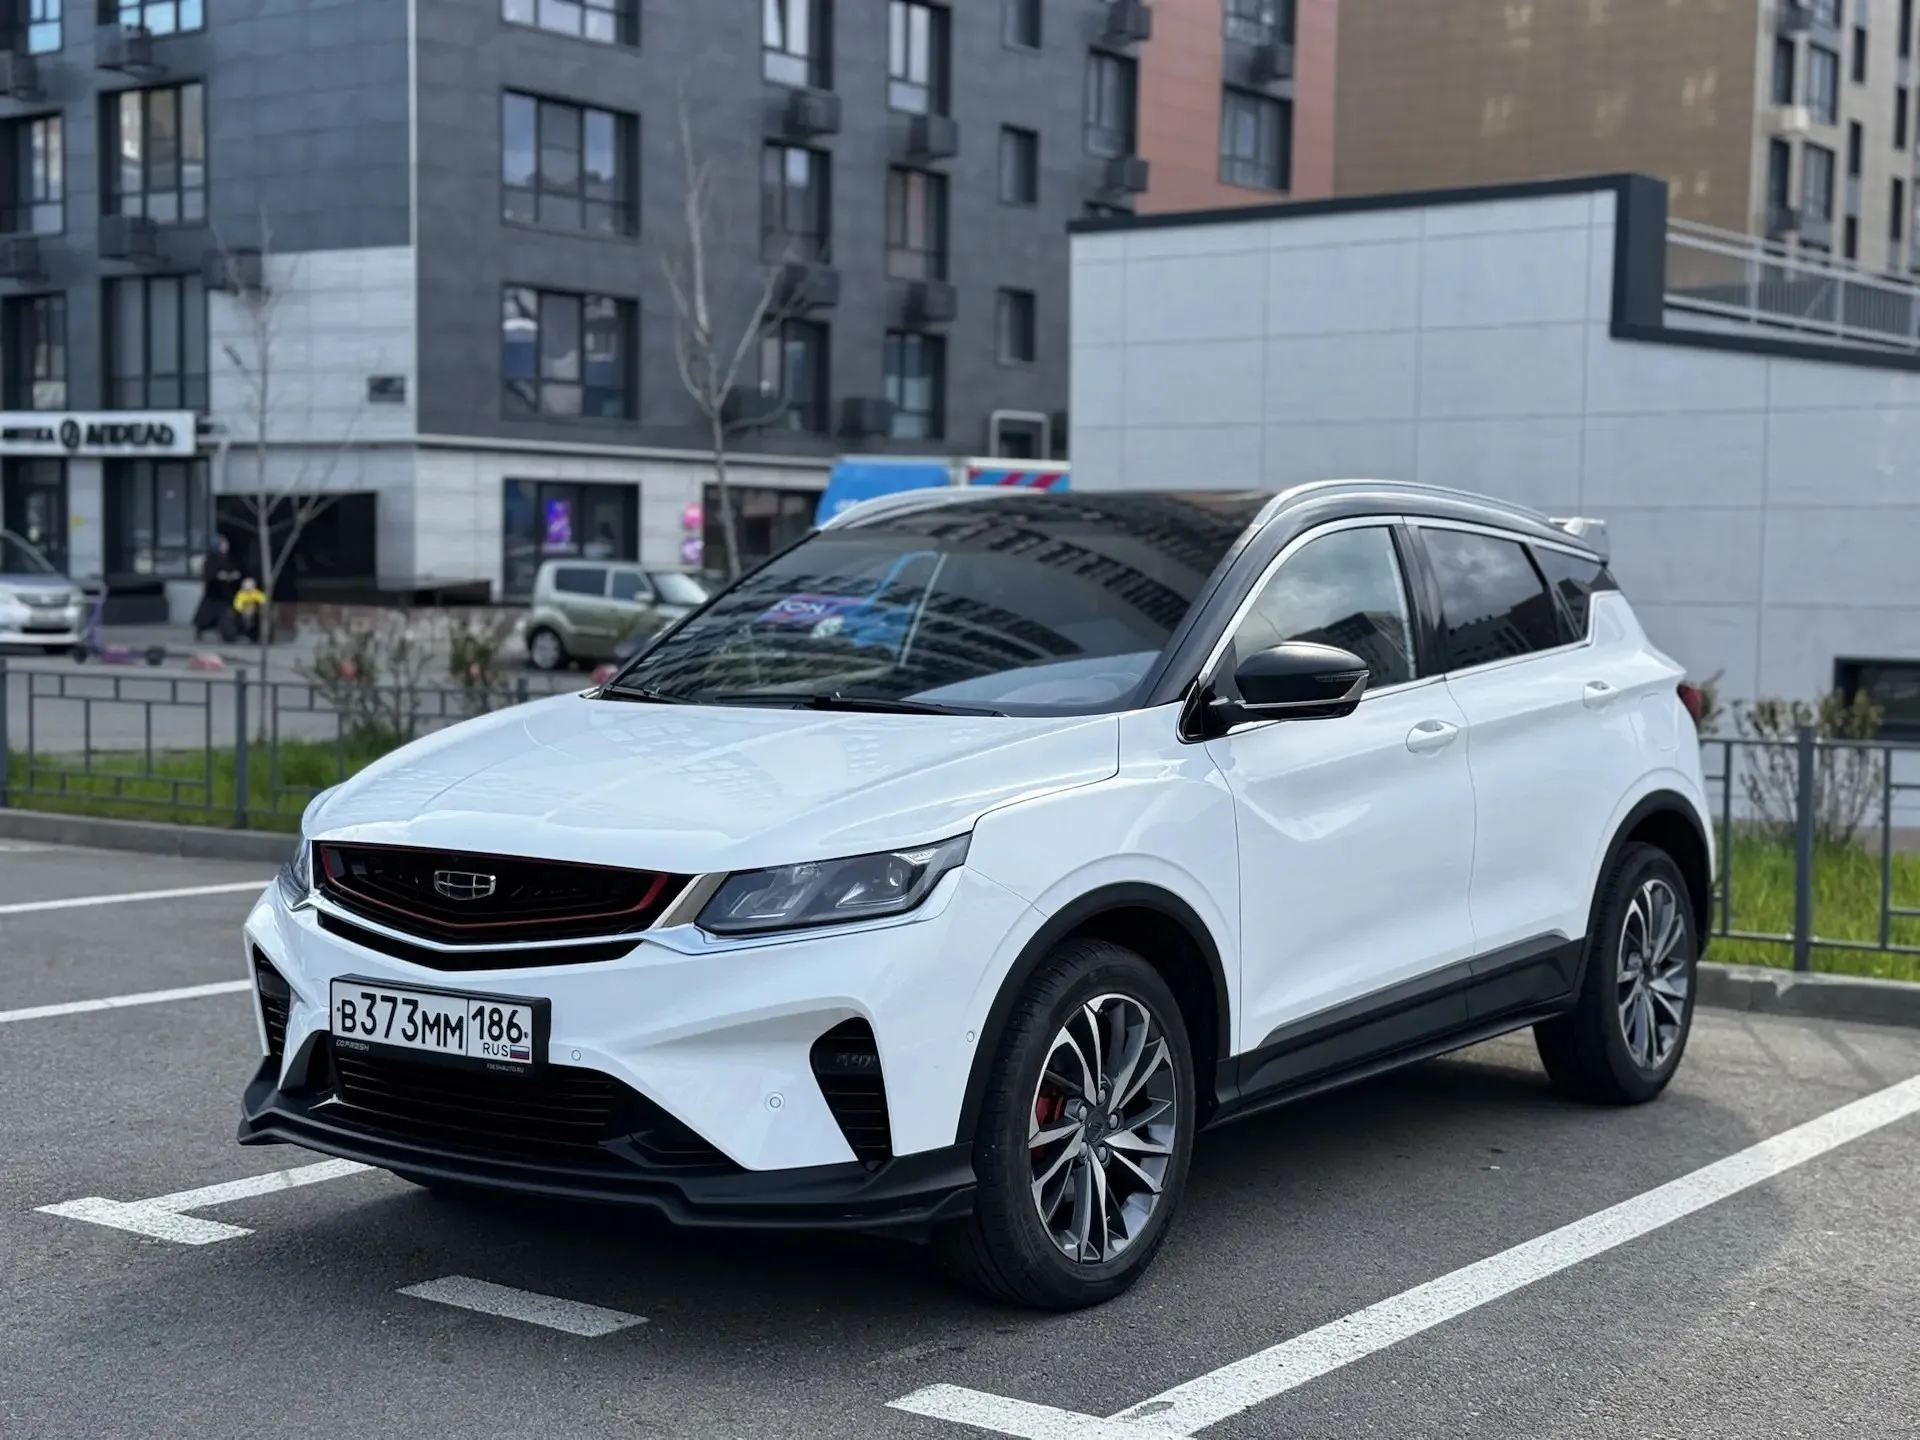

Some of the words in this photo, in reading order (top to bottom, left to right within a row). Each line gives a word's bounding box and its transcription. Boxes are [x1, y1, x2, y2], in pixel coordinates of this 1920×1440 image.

[341, 992, 463, 1049] В373ММ
[471, 1005, 523, 1043] 186
[482, 1042, 508, 1057] RUS
